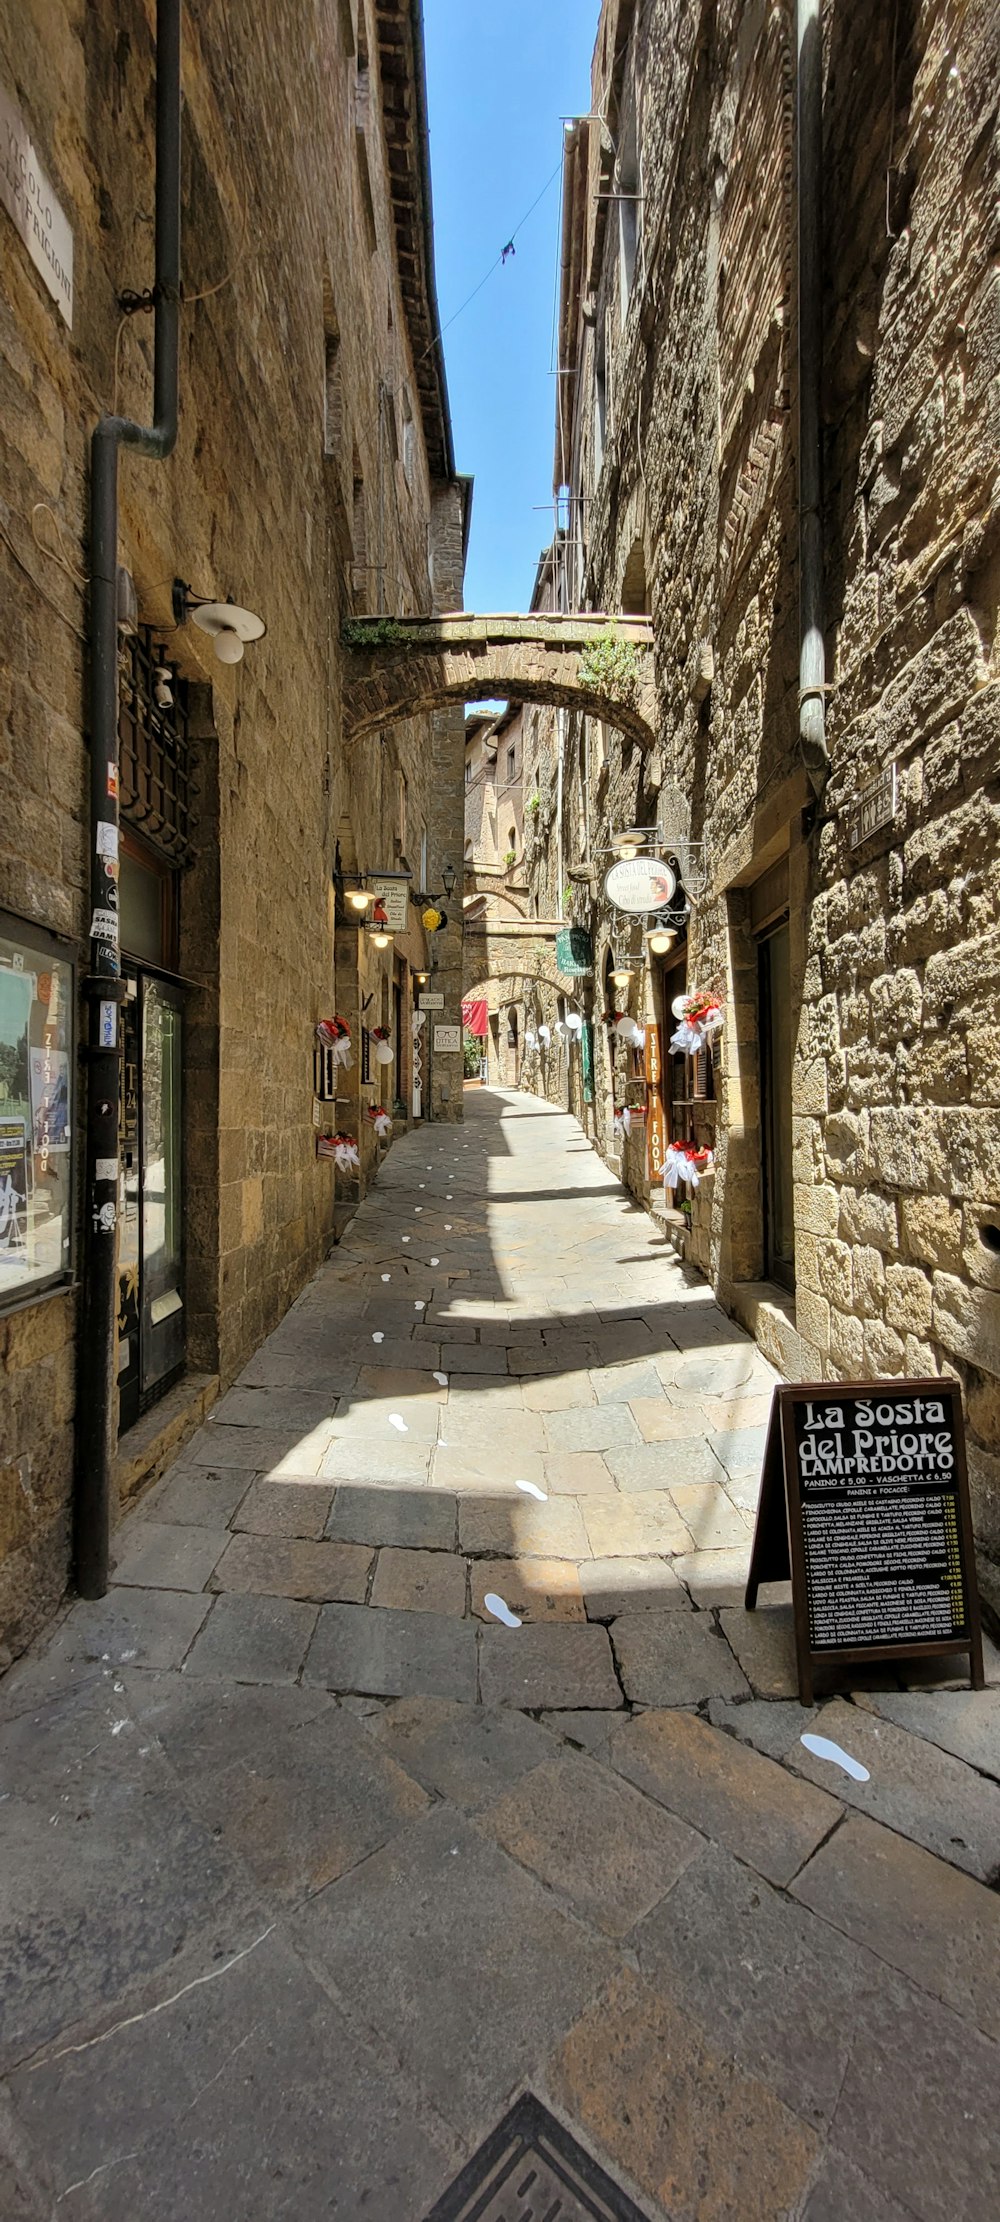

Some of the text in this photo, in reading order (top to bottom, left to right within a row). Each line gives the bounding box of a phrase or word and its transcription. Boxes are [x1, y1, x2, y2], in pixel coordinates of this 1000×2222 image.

[25, 196, 72, 302] PRIGIONI
[652, 1121, 660, 1171] FOOD
[804, 1398, 945, 1430] La Sosta
[799, 1430, 953, 1460] del Priore
[801, 1452, 954, 1476] LAMPREDOTTO
[804, 1479, 837, 1487] PANINO
[876, 1474, 924, 1484] VASCHETTA
